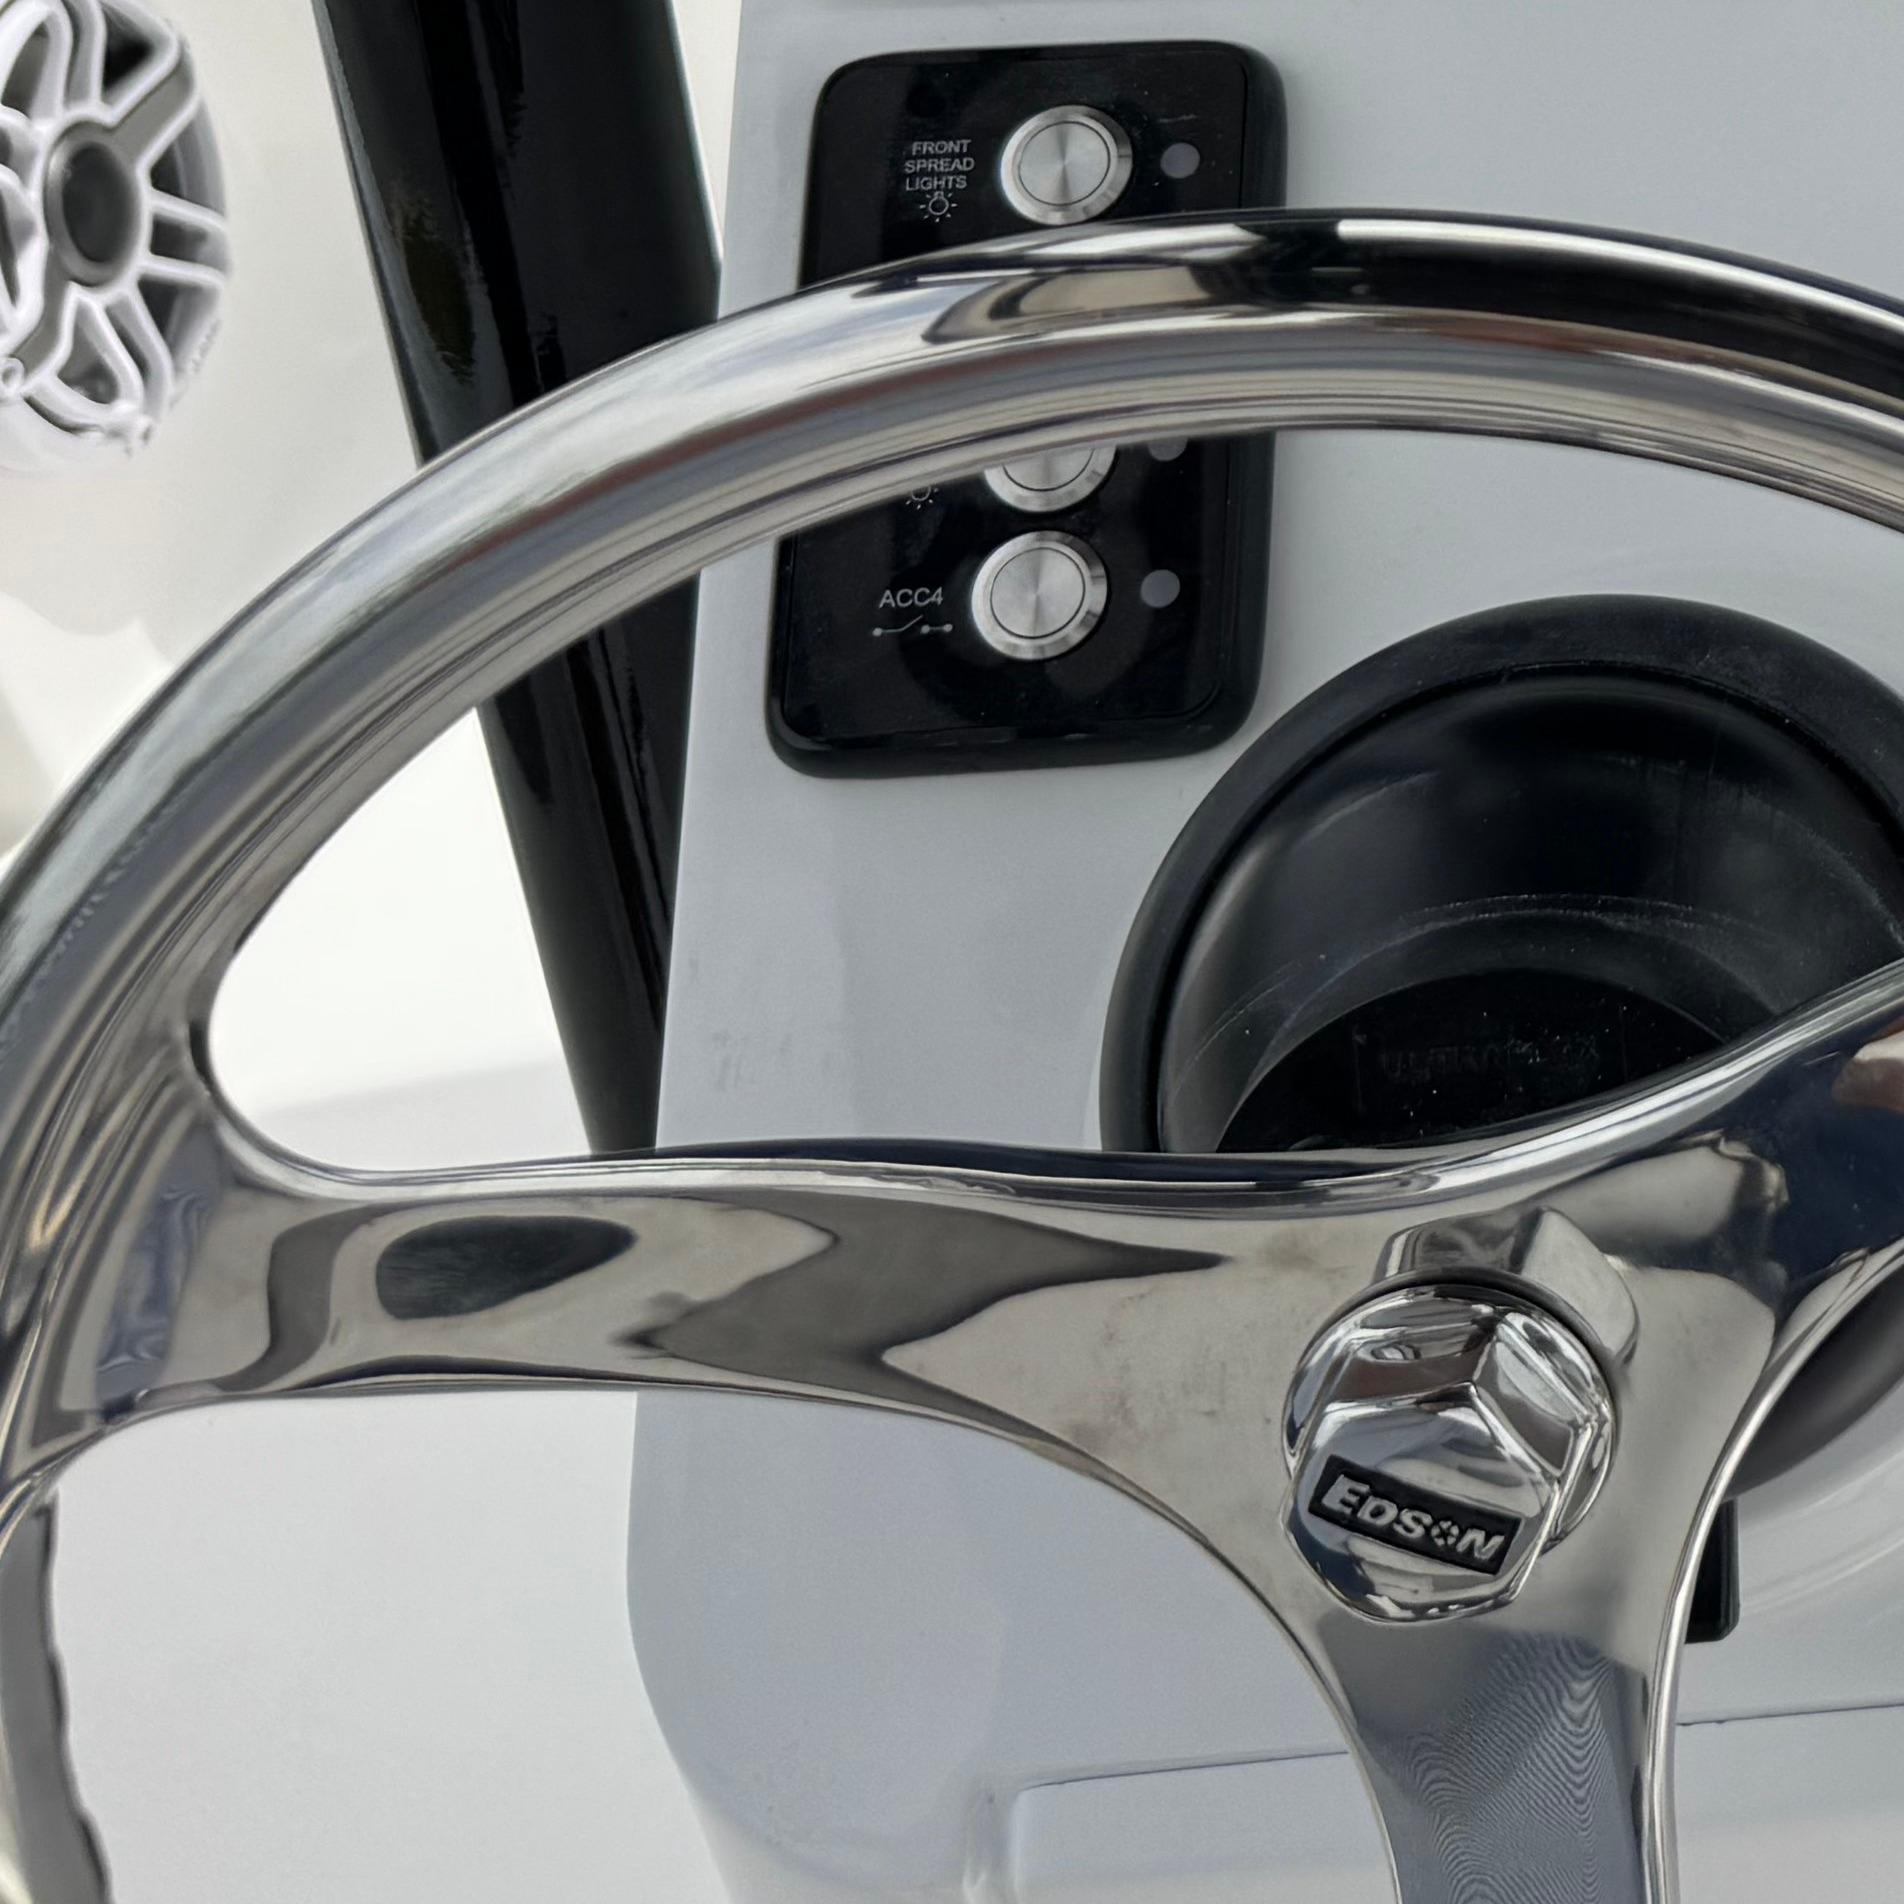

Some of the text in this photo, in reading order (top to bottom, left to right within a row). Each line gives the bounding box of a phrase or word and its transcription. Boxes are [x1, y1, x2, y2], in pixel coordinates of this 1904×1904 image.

[912, 139, 972, 157] FRONT
[904, 156, 975, 174] SPREAD
[905, 173, 967, 191] LIGHTS
[878, 586, 944, 609] ACC4
[1322, 1472, 1505, 1562] EDSON
